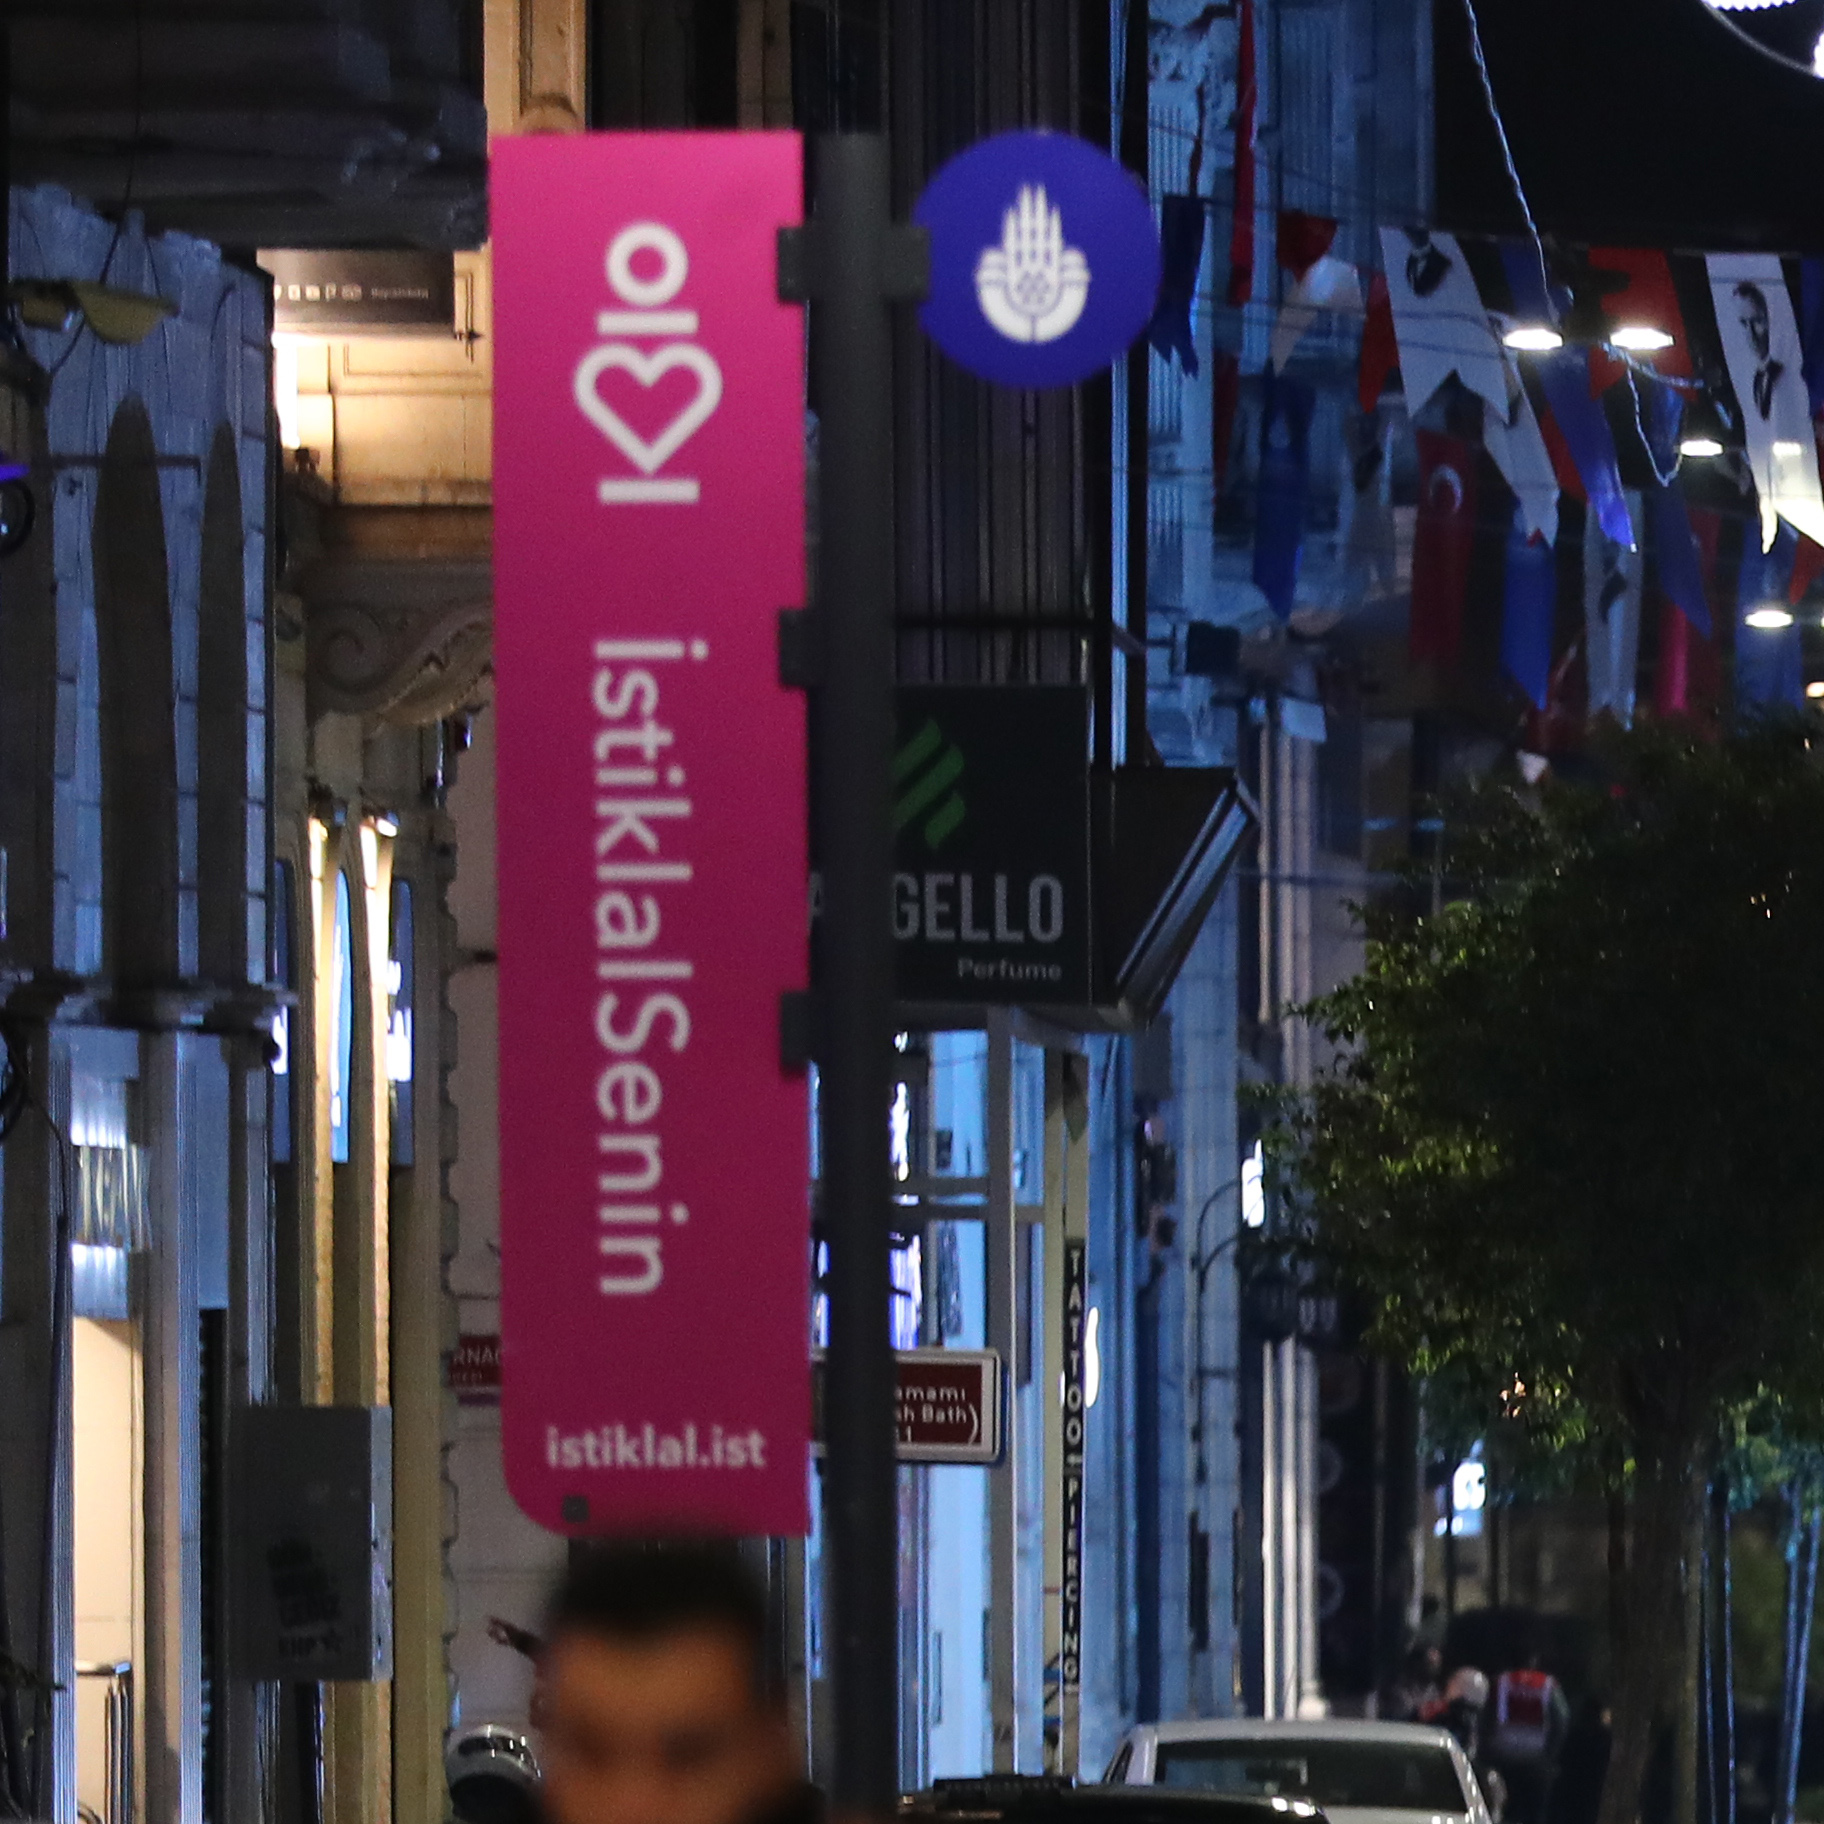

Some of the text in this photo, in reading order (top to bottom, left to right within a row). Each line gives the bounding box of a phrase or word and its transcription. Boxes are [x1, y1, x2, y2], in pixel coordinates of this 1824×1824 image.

[957, 957, 1062, 981] Perfume
[1066, 1249, 1082, 1445] TATTOO
[546, 1421, 767, 1468] istiklal.ist
